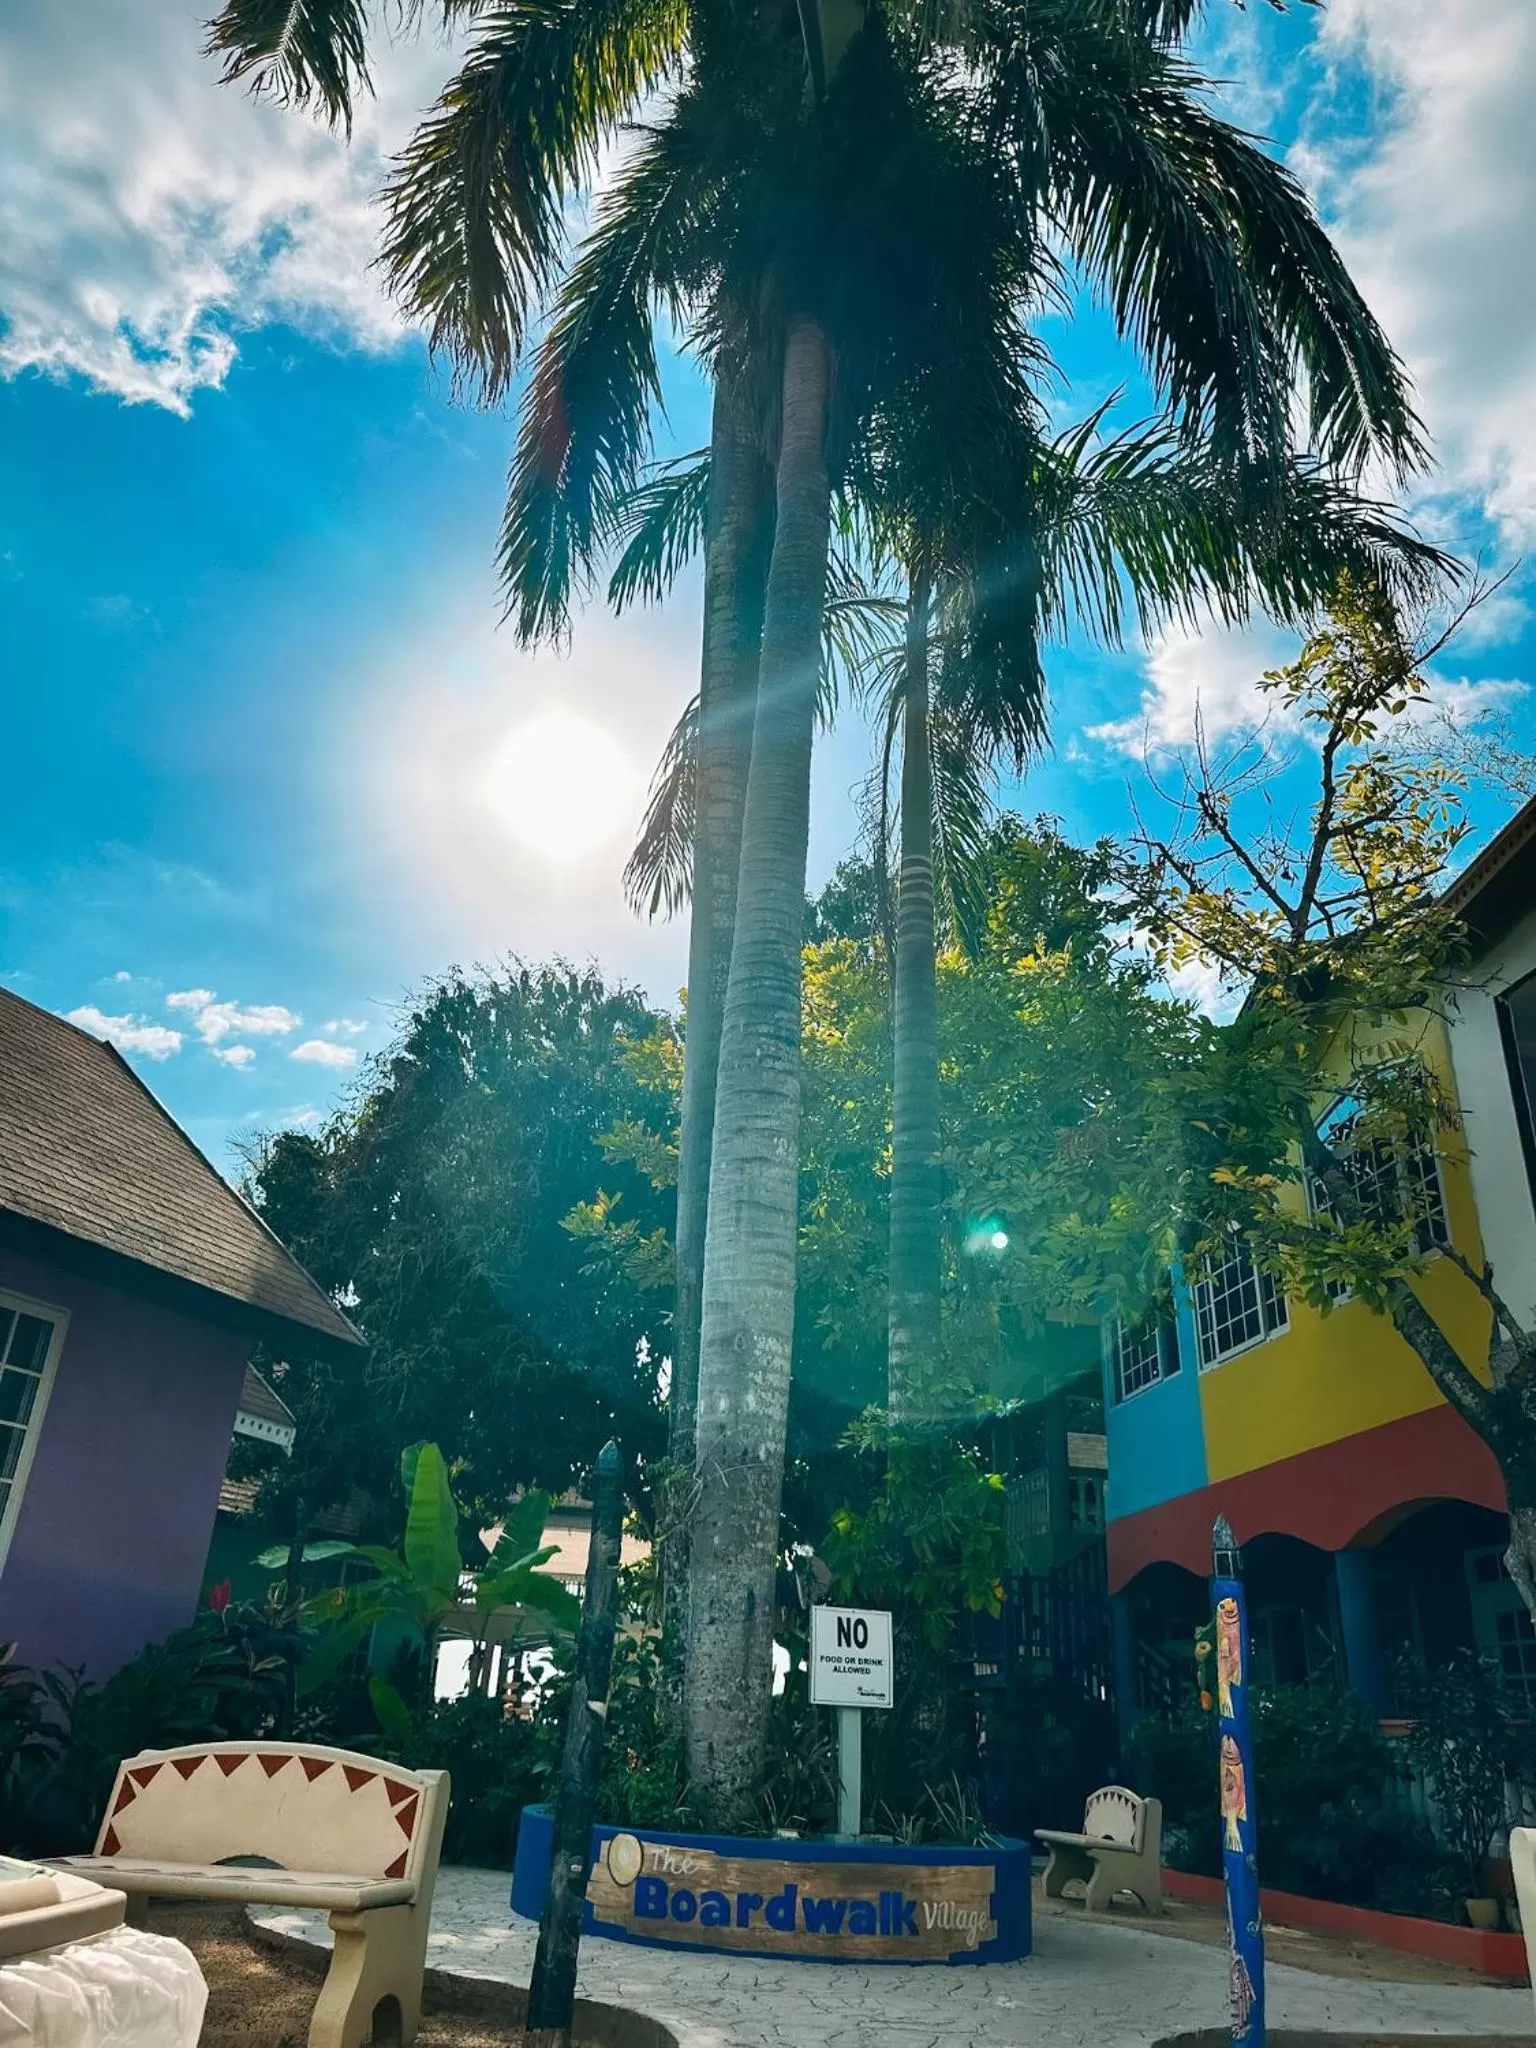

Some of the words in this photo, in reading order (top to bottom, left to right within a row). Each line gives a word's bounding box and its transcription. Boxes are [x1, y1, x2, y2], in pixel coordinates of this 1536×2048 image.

[837, 1616, 868, 1649] NO
[820, 1655, 842, 1663] FOOD
[858, 1658, 883, 1666] DRINK
[832, 1666, 871, 1674] ALLOWED
[651, 1848, 698, 1874] The
[634, 1876, 920, 1936] Boardwalk
[922, 1900, 989, 1947] Village
